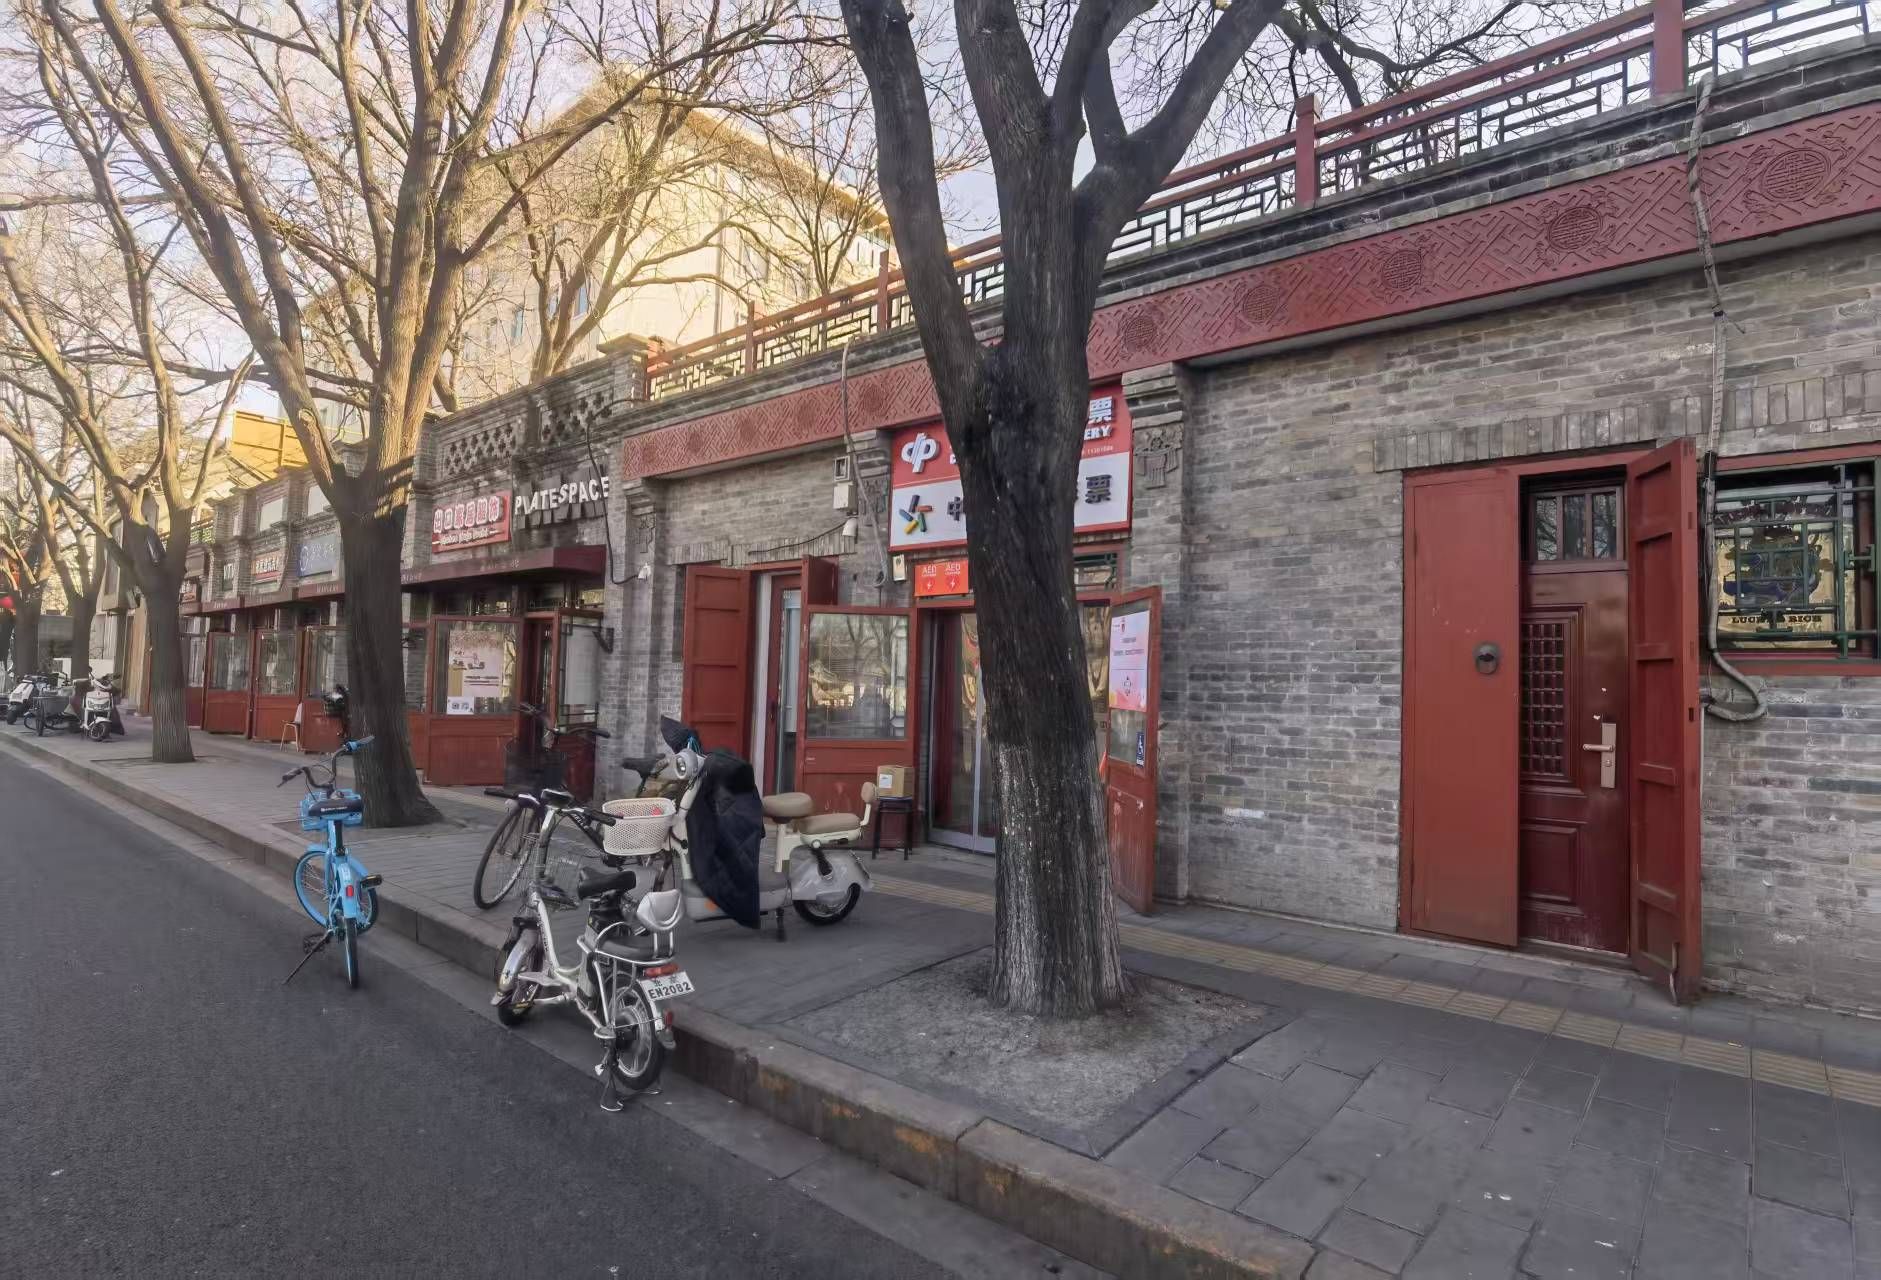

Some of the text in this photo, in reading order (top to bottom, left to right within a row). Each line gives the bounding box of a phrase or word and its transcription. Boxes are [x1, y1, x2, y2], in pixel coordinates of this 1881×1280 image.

[1085, 474, 1112, 504] 票
[922, 564, 937, 574] AED
[945, 561, 961, 571] AED
